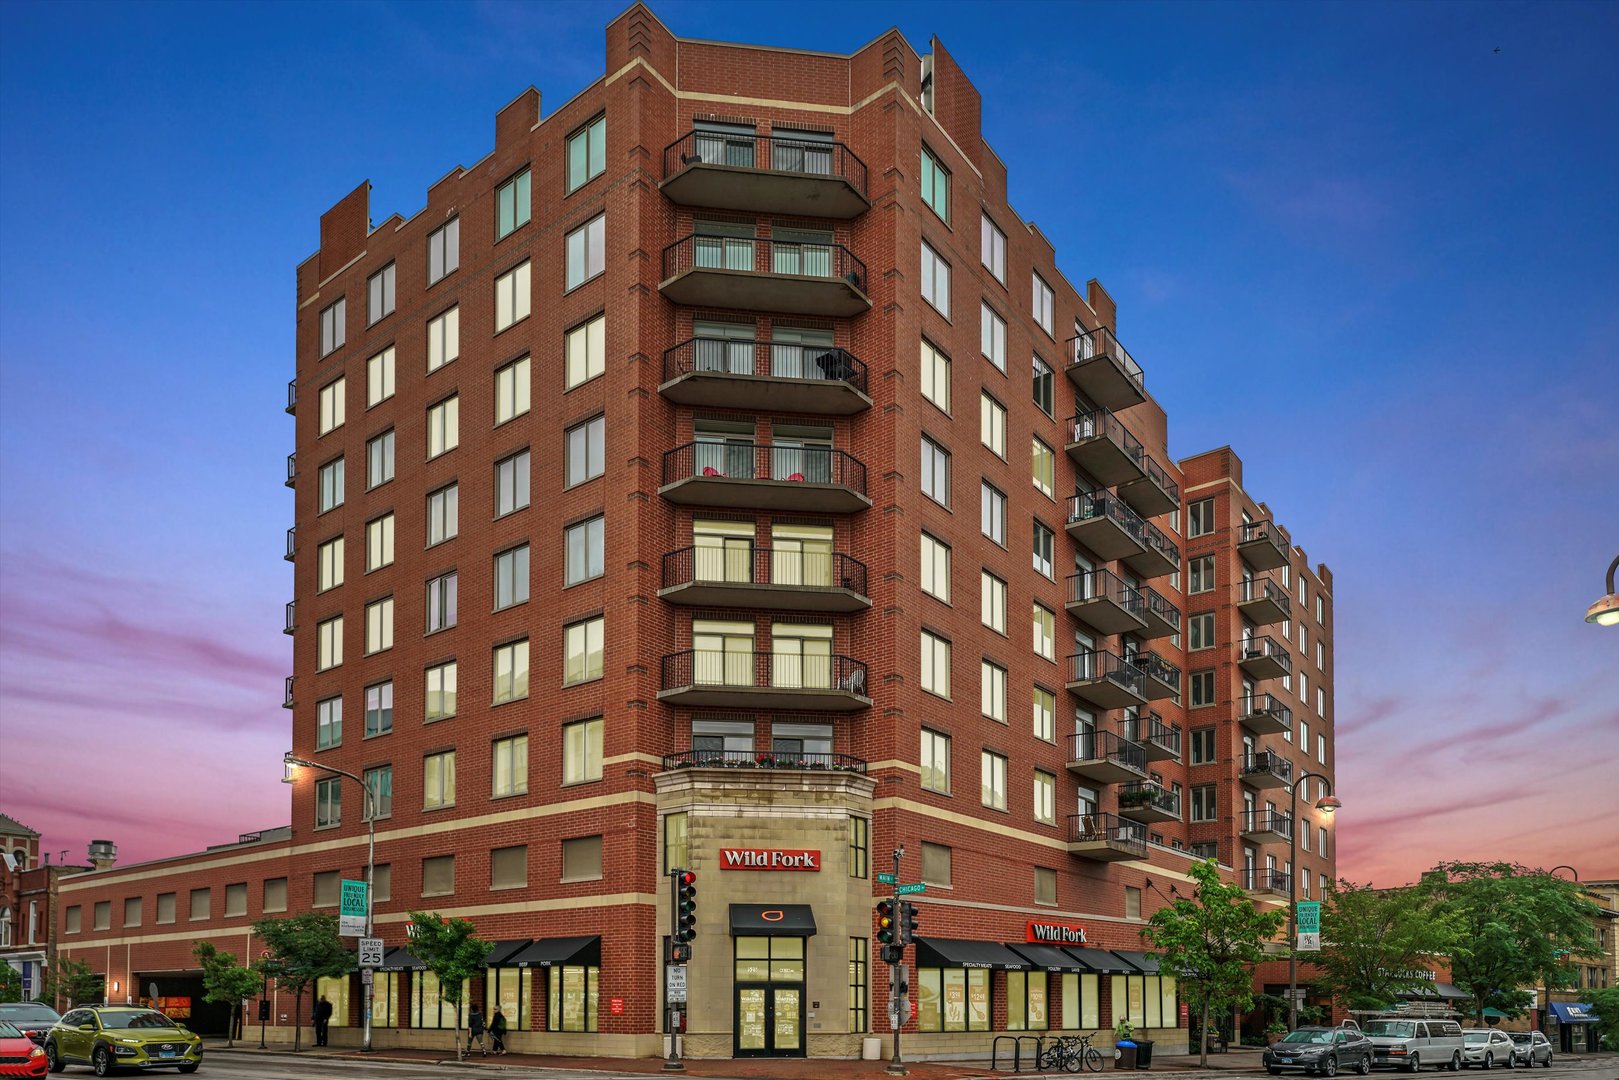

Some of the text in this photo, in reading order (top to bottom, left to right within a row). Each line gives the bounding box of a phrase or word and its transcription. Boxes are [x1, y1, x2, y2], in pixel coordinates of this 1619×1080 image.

[724, 850, 815, 867] Wild Fork
[343, 884, 365, 893] UNIQUE
[899, 884, 921, 893] CHICAGO
[343, 898, 365, 908] LOCAL
[1298, 905, 1318, 913] UNIQUE
[1299, 917, 1317, 925] LOCAL
[1033, 924, 1088, 943] Wild Fork
[361, 952, 381, 963] 25
[1414, 970, 1436, 981] COFFEE
